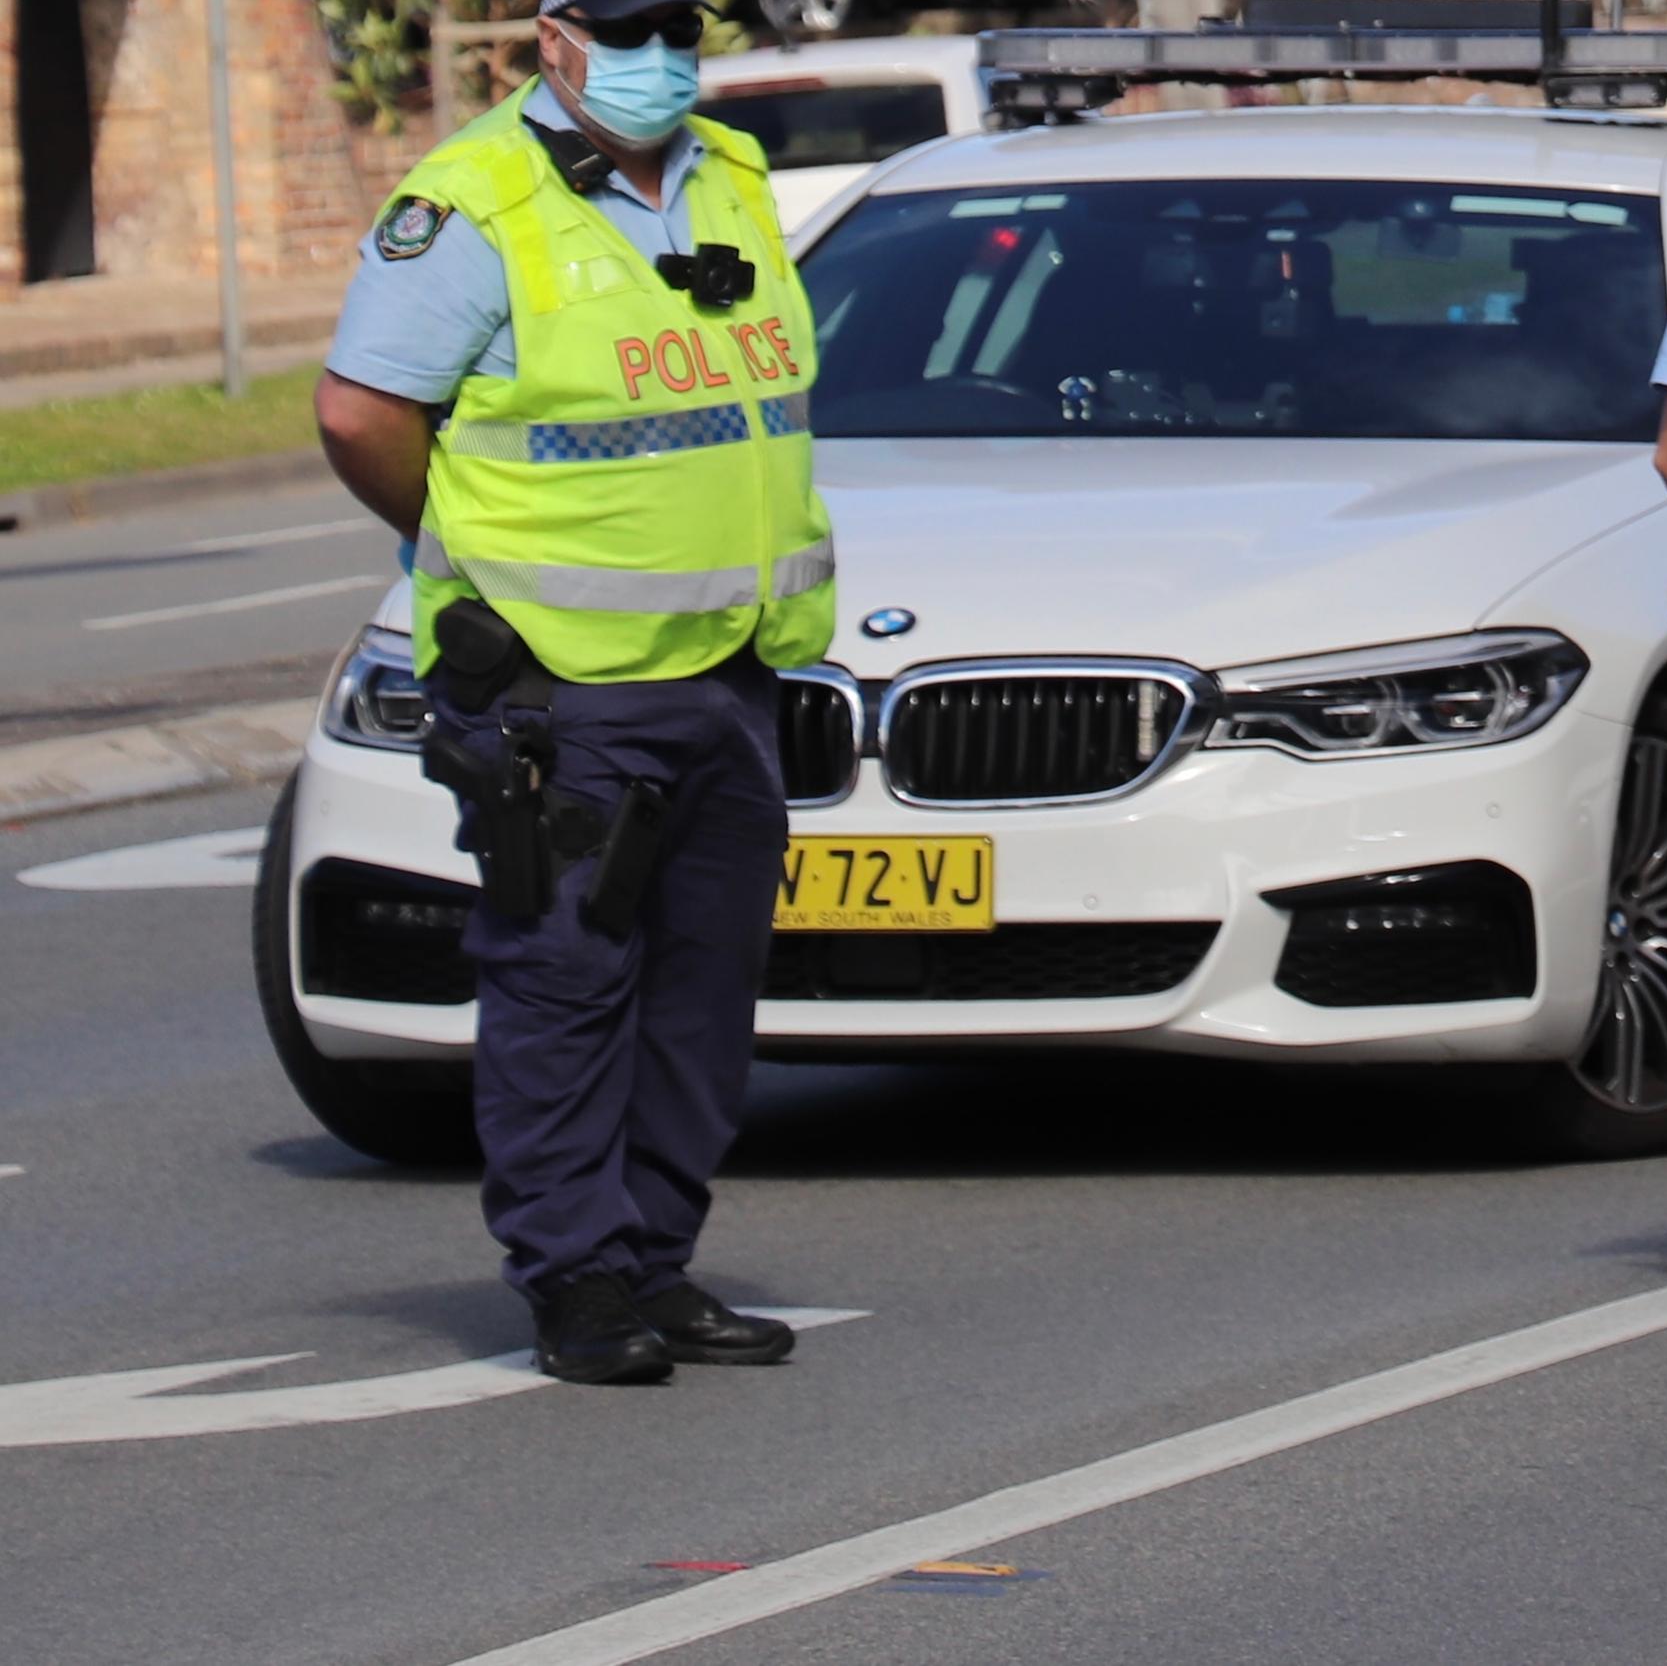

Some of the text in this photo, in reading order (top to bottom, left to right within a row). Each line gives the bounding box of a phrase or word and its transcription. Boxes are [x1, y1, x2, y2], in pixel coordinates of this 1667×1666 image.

[614, 317, 800, 401] POLICE
[817, 911, 880, 926] SOUTH
[890, 911, 953, 926] WALES
